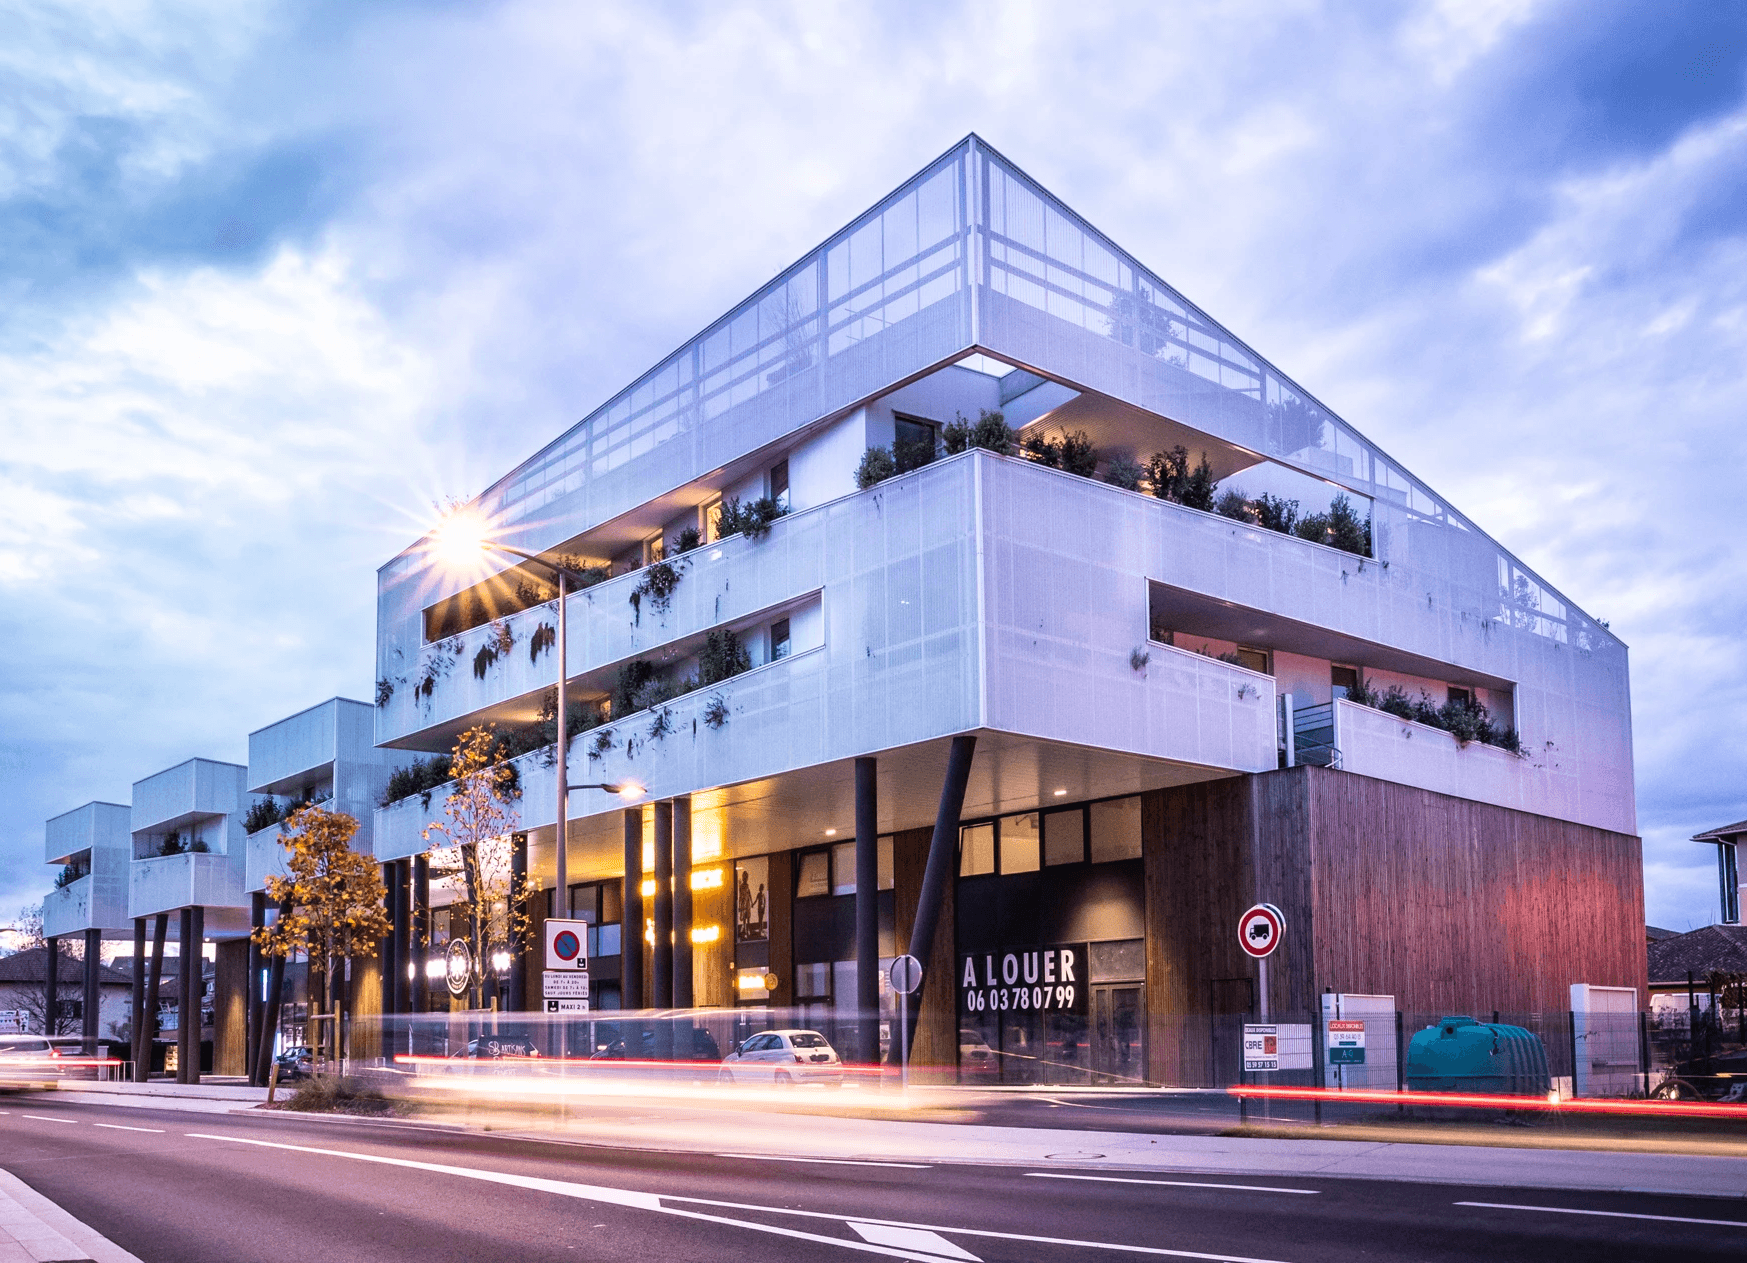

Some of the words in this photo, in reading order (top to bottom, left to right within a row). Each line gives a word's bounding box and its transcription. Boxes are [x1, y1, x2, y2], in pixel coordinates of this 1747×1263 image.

[963, 957, 977, 988] A
[986, 949, 1075, 986] LOUER
[967, 990, 985, 1011] 06
[990, 988, 1009, 1010] 03
[1012, 987, 1029, 1010] 78
[1033, 986, 1053, 1009] 07
[1056, 985, 1075, 1009] 99
[1245, 1040, 1263, 1050] CBRE
